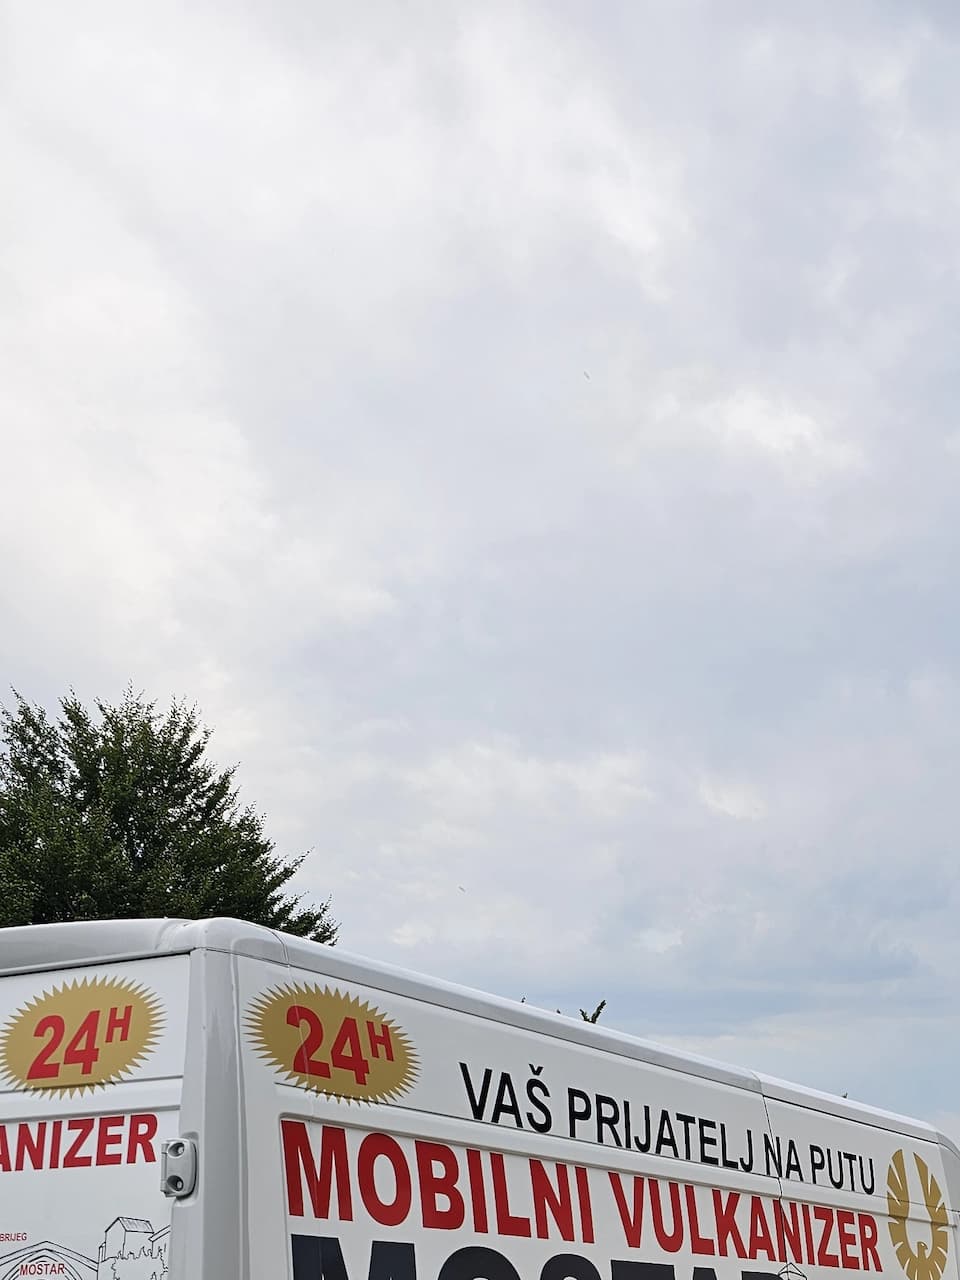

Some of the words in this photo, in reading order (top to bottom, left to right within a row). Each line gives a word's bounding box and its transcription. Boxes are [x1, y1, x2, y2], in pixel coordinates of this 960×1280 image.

[27, 1004, 133, 1080] 24H
[286, 1005, 395, 1086] 24H
[459, 1062, 552, 1134] VAŠ
[568, 1088, 754, 1173] PRIJATELJ
[764, 1133, 803, 1182] NA
[809, 1145, 875, 1195] PUTU
[280, 1120, 594, 1243] MOBILNI
[608, 1172, 883, 1272] VULKANIZER
[20, 1263, 65, 1276] MOSTAR
